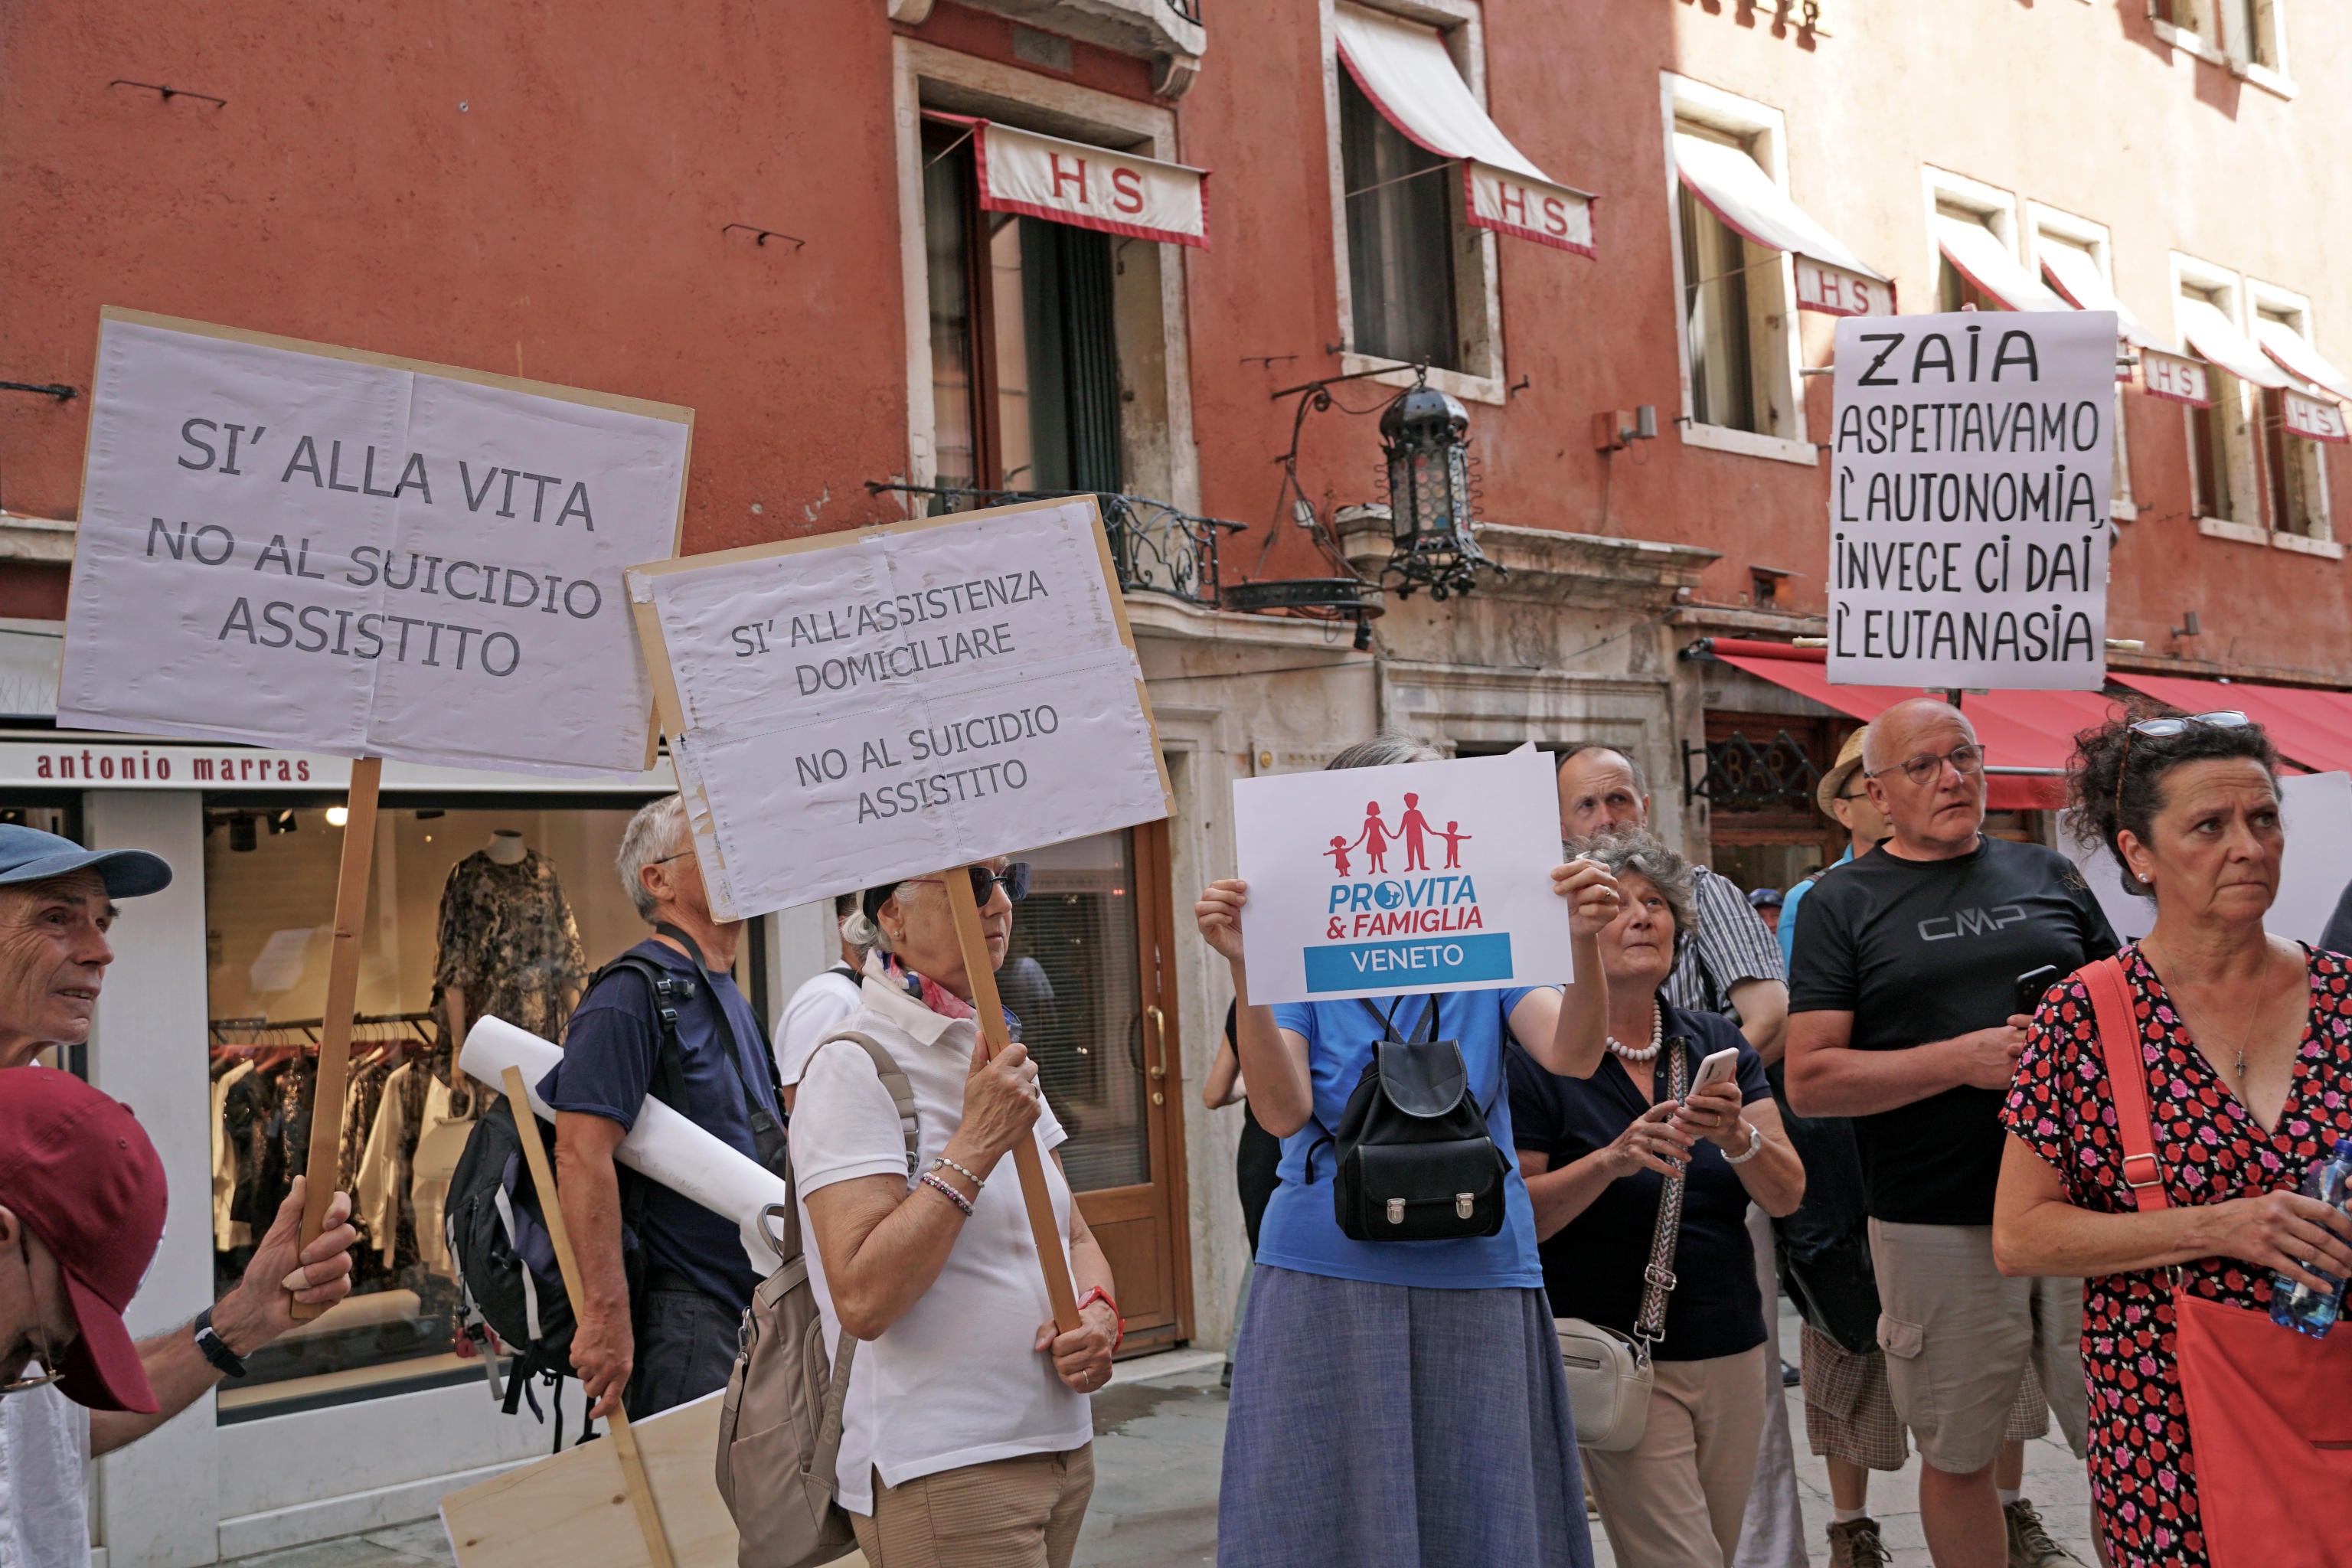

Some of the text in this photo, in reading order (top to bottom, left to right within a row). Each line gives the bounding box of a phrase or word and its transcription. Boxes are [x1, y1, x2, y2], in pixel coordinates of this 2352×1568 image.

[1857, 325, 2039, 386] ZAIA
[1838, 400, 2099, 454] ASPETTAVAMO
[177, 418, 595, 533] SI' ALLA VITA
[146, 518, 602, 619] NO AL SUICIDIO
[1835, 533, 2092, 593] INVECE CI DAI
[218, 597, 521, 677] ASSISTITO
[731, 570, 1048, 658] SI' ALL'ASSISTENZA
[795, 623, 1016, 697] DOMICILIARE
[38, 750, 310, 782] antonio marras
[795, 704, 1059, 787] NO AL SUICIDIO
[857, 759, 1028, 824] ASSISTITO
[1326, 906, 1483, 939] & FAMIGLIA
[1917, 904, 2027, 941] CMP
[1350, 943, 1464, 973] VENETO
